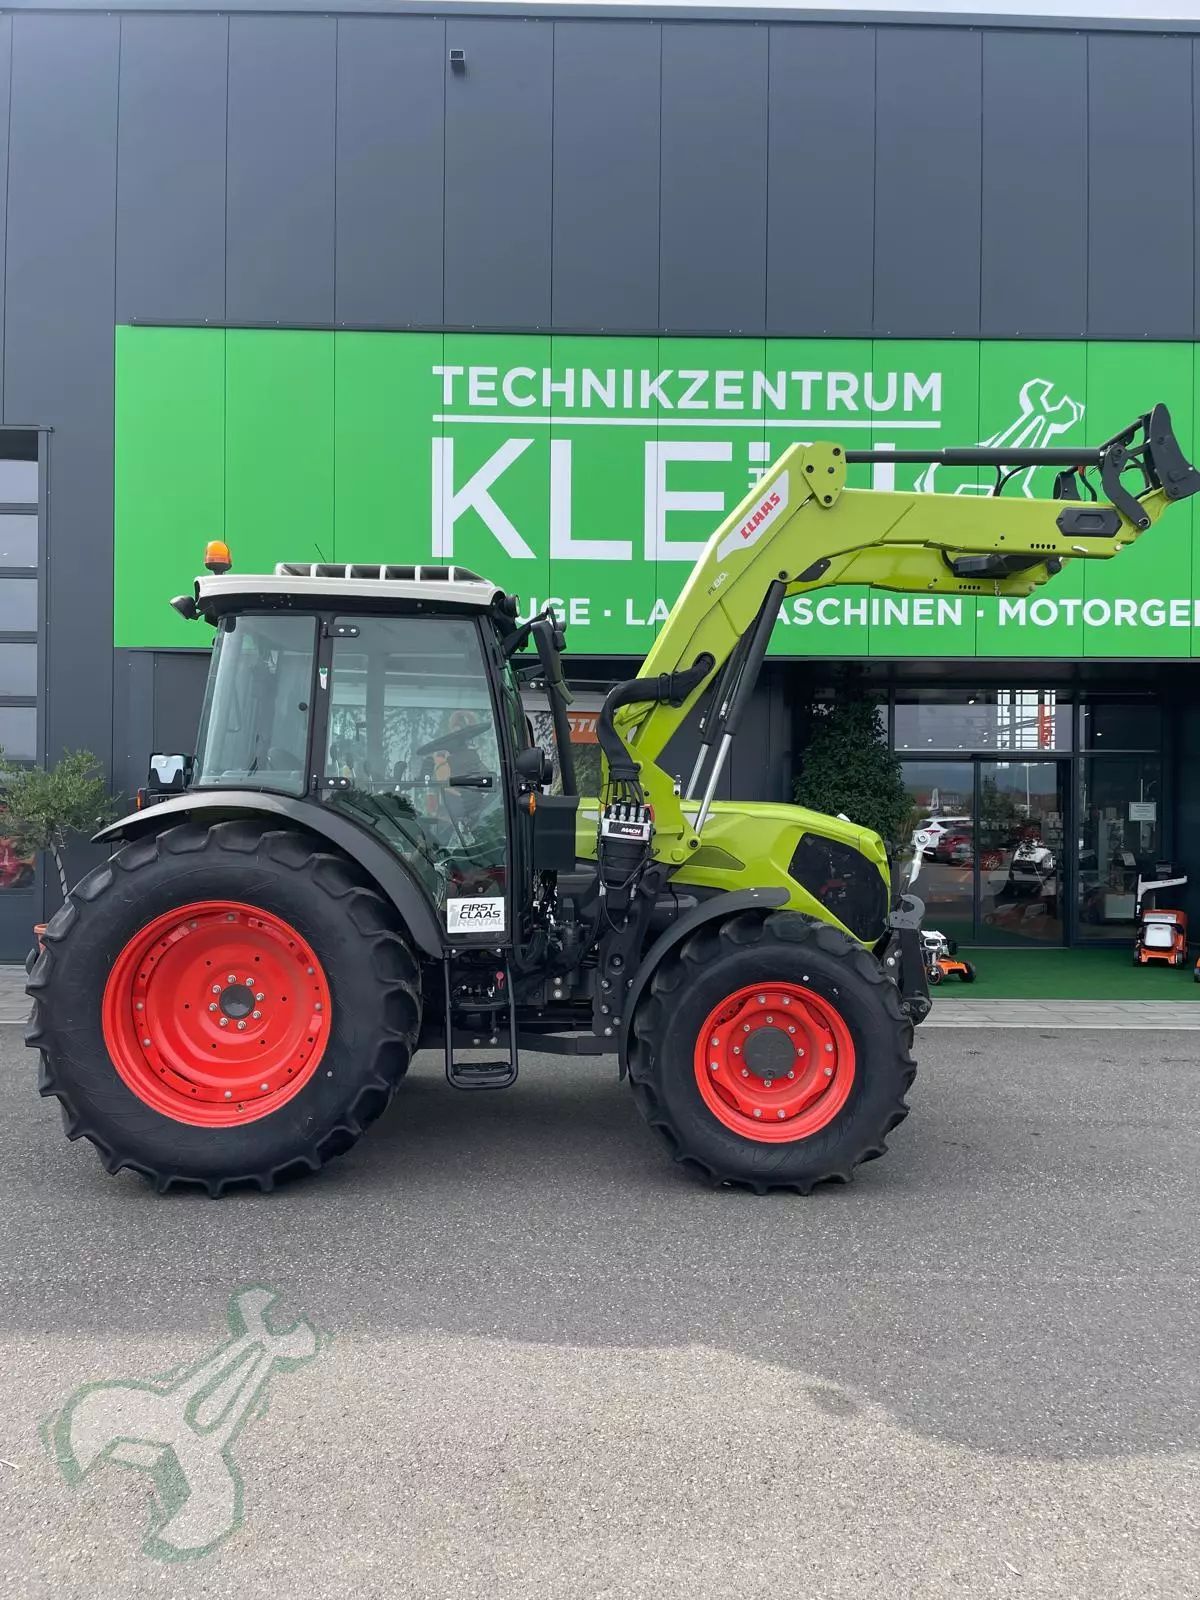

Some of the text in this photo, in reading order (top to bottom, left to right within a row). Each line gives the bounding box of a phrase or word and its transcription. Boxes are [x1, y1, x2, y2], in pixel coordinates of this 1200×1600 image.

[432, 365, 942, 412] TECHNIKZENTRUM
[431, 436, 896, 561] KLE
[740, 492, 780, 540] CLAAS
[514, 597, 591, 626] UGE
[567, 718, 598, 733] STI
[459, 910, 501, 919] CLAAS
[461, 903, 496, 911] FIRST
[457, 918, 503, 927] RENTAL
